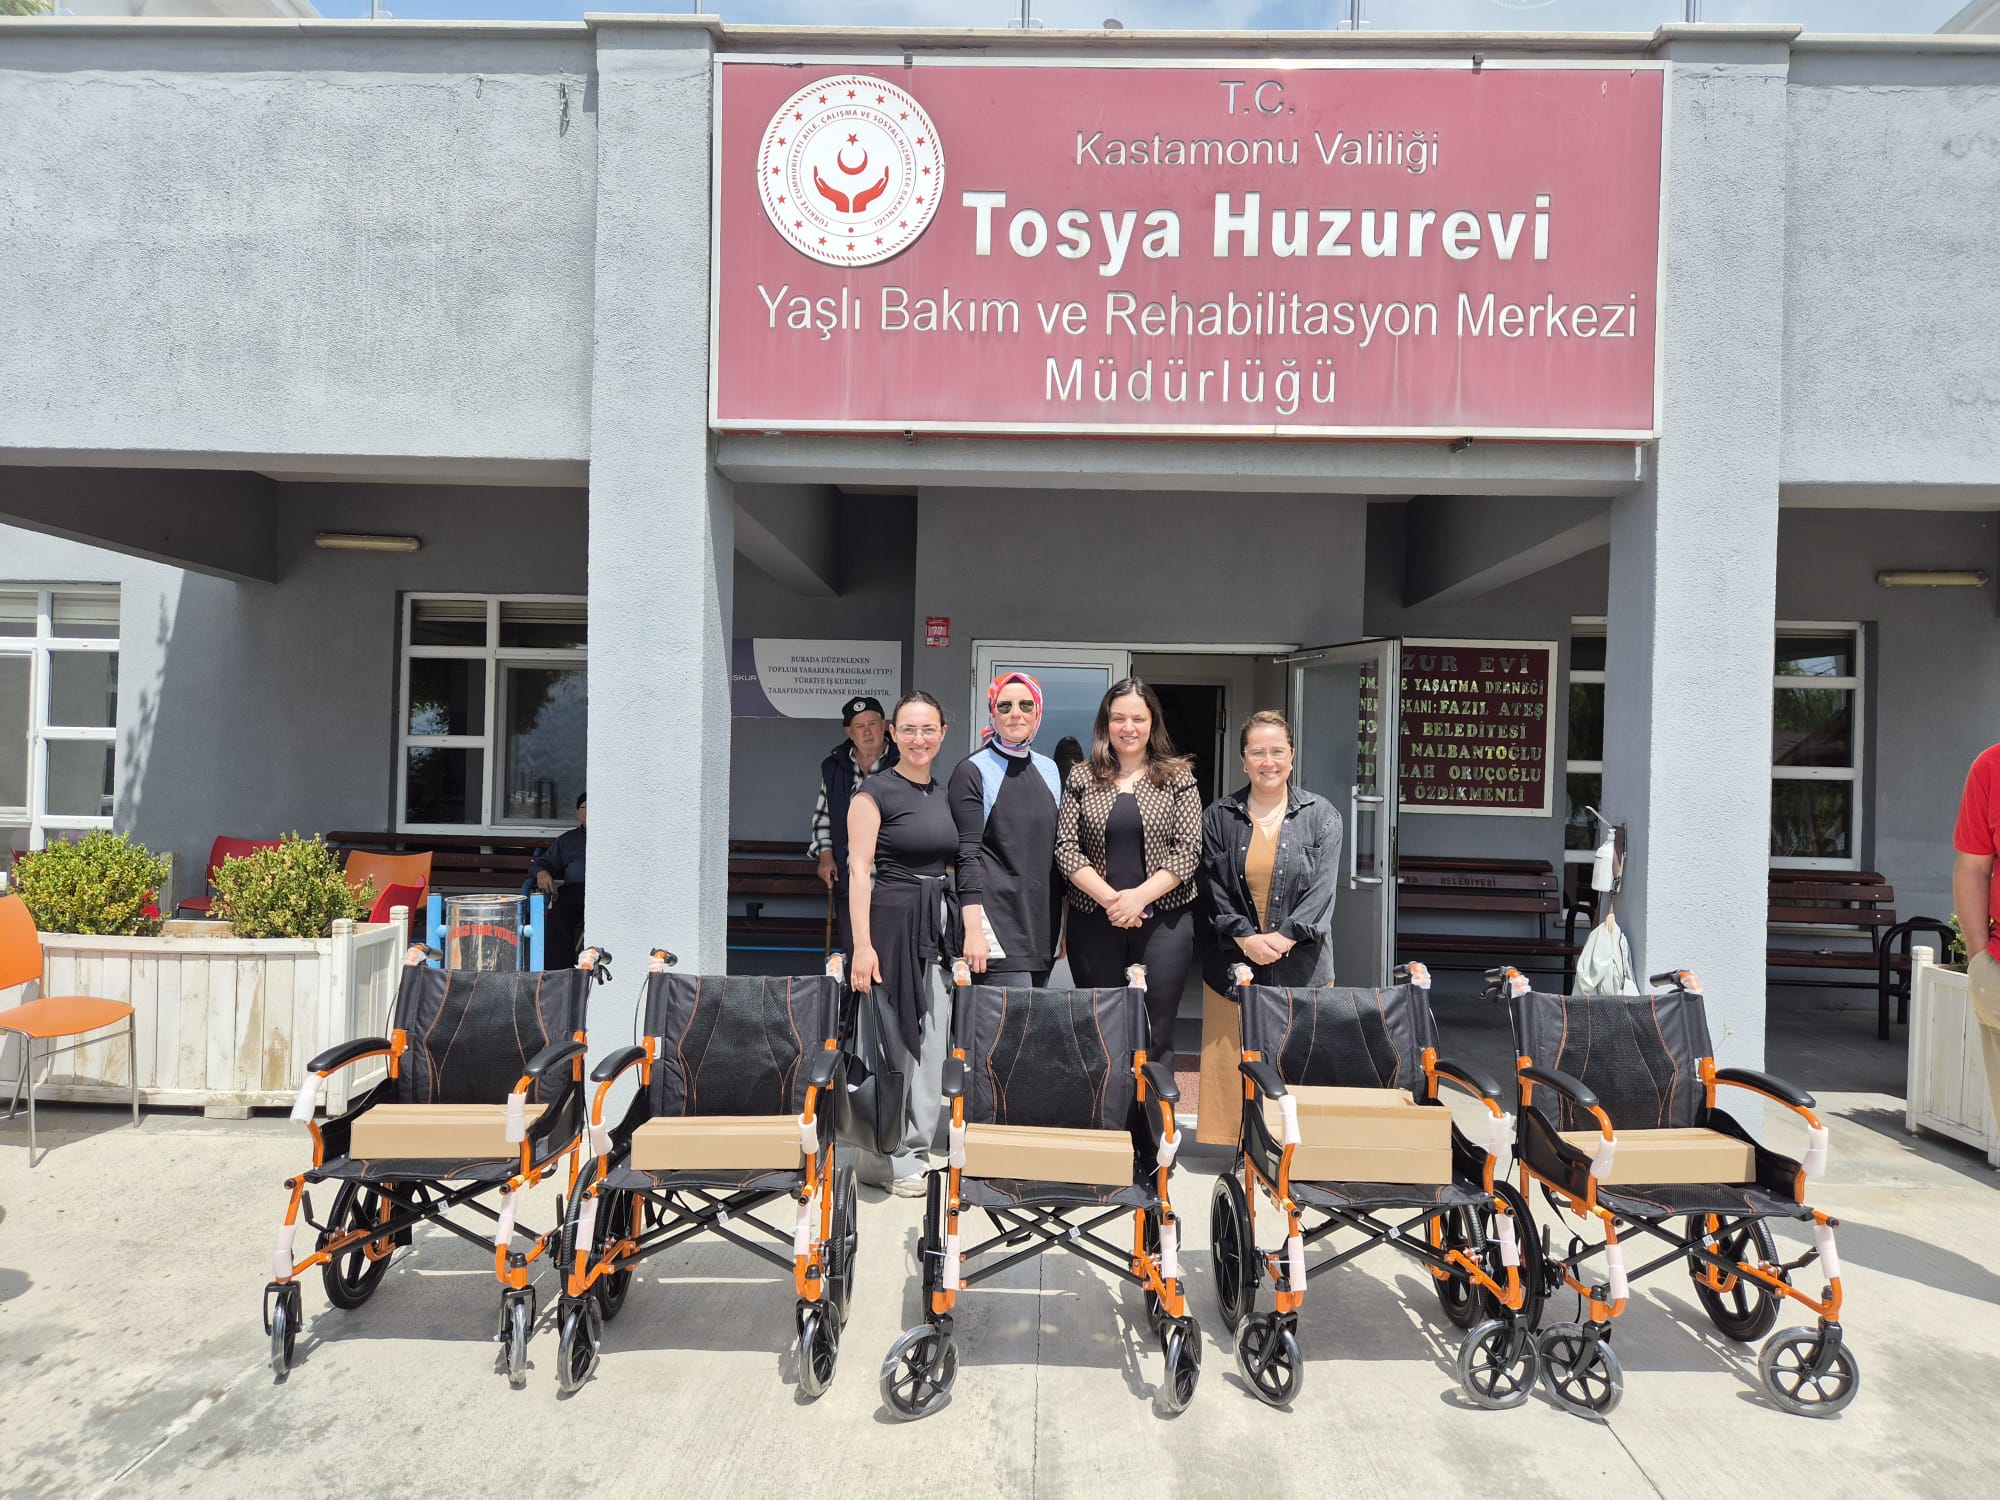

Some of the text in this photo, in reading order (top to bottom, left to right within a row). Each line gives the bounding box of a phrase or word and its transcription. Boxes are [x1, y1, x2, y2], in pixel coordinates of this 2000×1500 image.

[1220, 81, 1294, 115] T.C.
[820, 109, 858, 125] ÇALIŞMA
[860, 110, 871, 118] VE
[872, 115, 899, 140] SOSYAL
[1076, 130, 1439, 175] Kastamonu Valiliği
[961, 189, 1552, 278] Tosya Huzurevi
[757, 284, 1638, 349] Yaşlı Bakım ve Rehabilitasyon Merkezi
[1045, 356, 1336, 415] Müdürlüğü
[791, 655, 870, 664] BURADA DÜZENLENEN
[1403, 654, 1529, 674] ZUR EVİ
[768, 665, 893, 676] TOPLUM YARARINA PROGRAM (TYP)
[794, 675, 867, 685] TÜRKİYE İŞ KURUMU
[768, 686, 814, 695] TARAFINDAN
[815, 686, 846, 695] FİNANSE
[1414, 678, 1479, 695] YAŞATMA
[1485, 680, 1544, 695] DERNEĞİ
[1440, 700, 1489, 715] FAZIL
[1498, 702, 1544, 720] ATEŞ
[1423, 721, 1526, 739] BELEDİYESİ
[1411, 742, 1542, 760] NALBANTOĞLU
[1449, 763, 1541, 784] ORUÇOĞLU
[1415, 782, 1524, 802] ÖZDİKMENLİ
